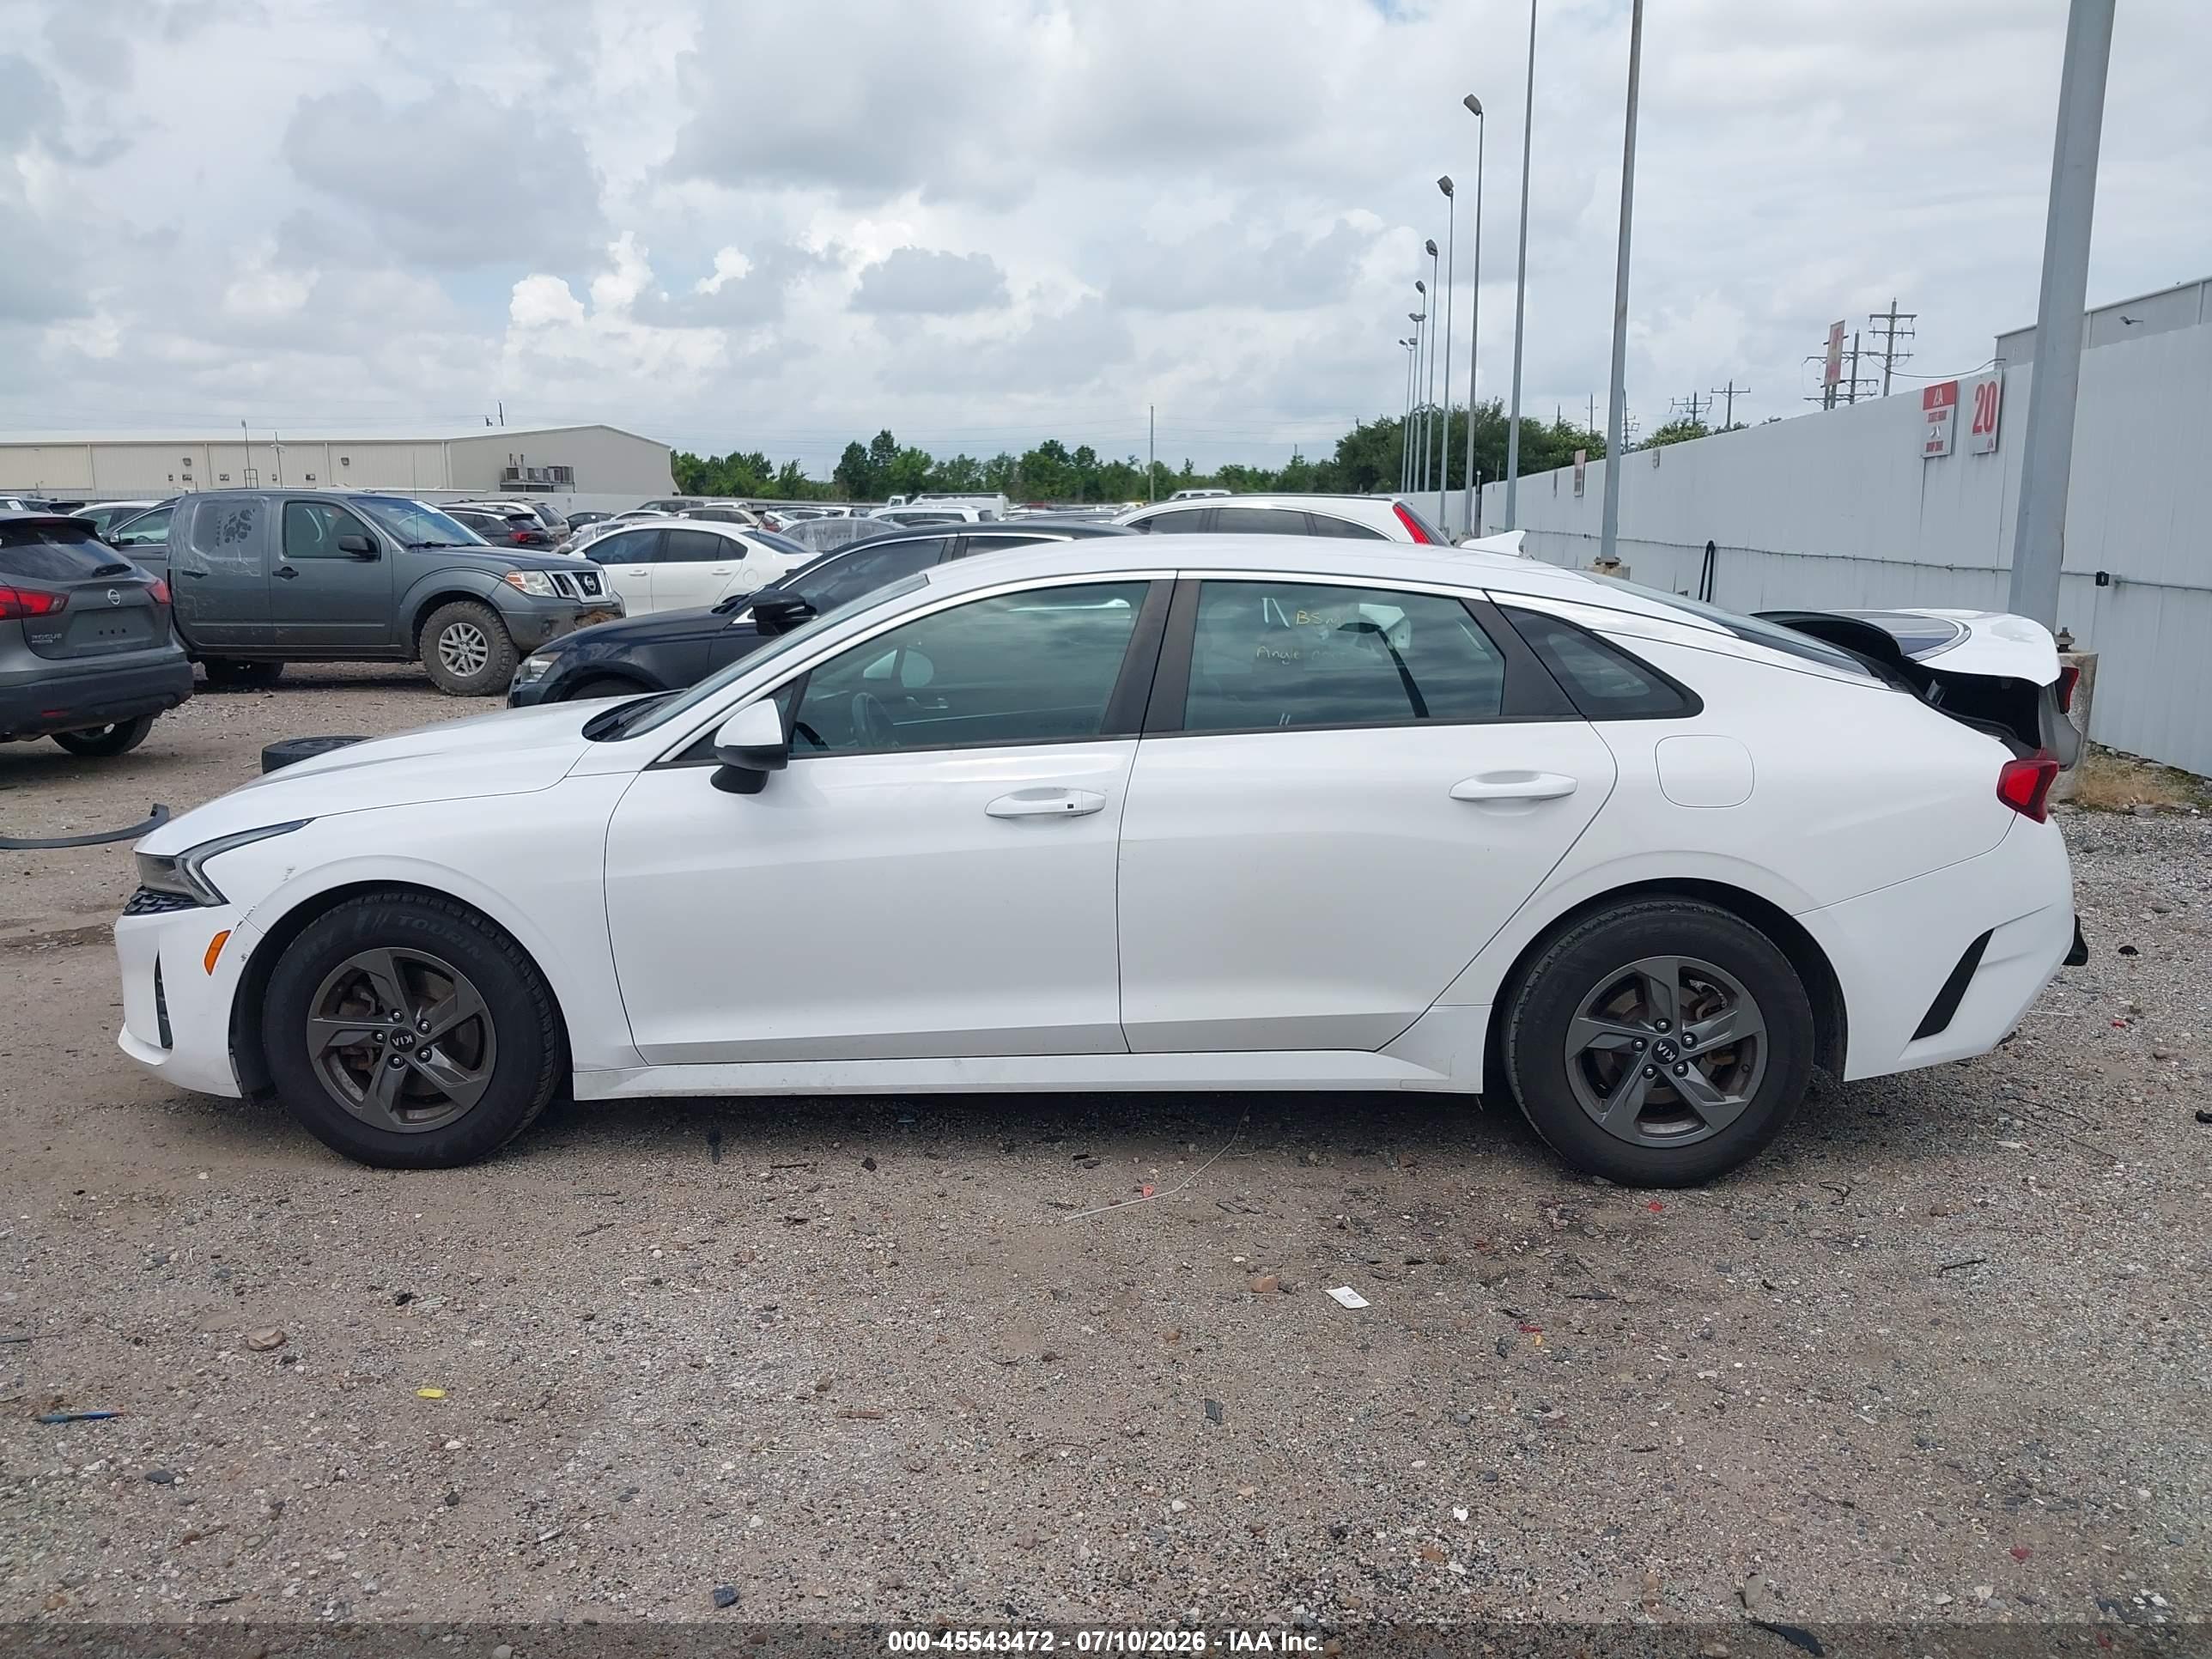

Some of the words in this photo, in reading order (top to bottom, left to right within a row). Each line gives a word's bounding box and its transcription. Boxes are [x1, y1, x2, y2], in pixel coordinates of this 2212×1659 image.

[1972, 380, 1997, 434] 20
[392, 1035, 413, 1046] KIA
[1657, 1042, 1676, 1061] KIA
